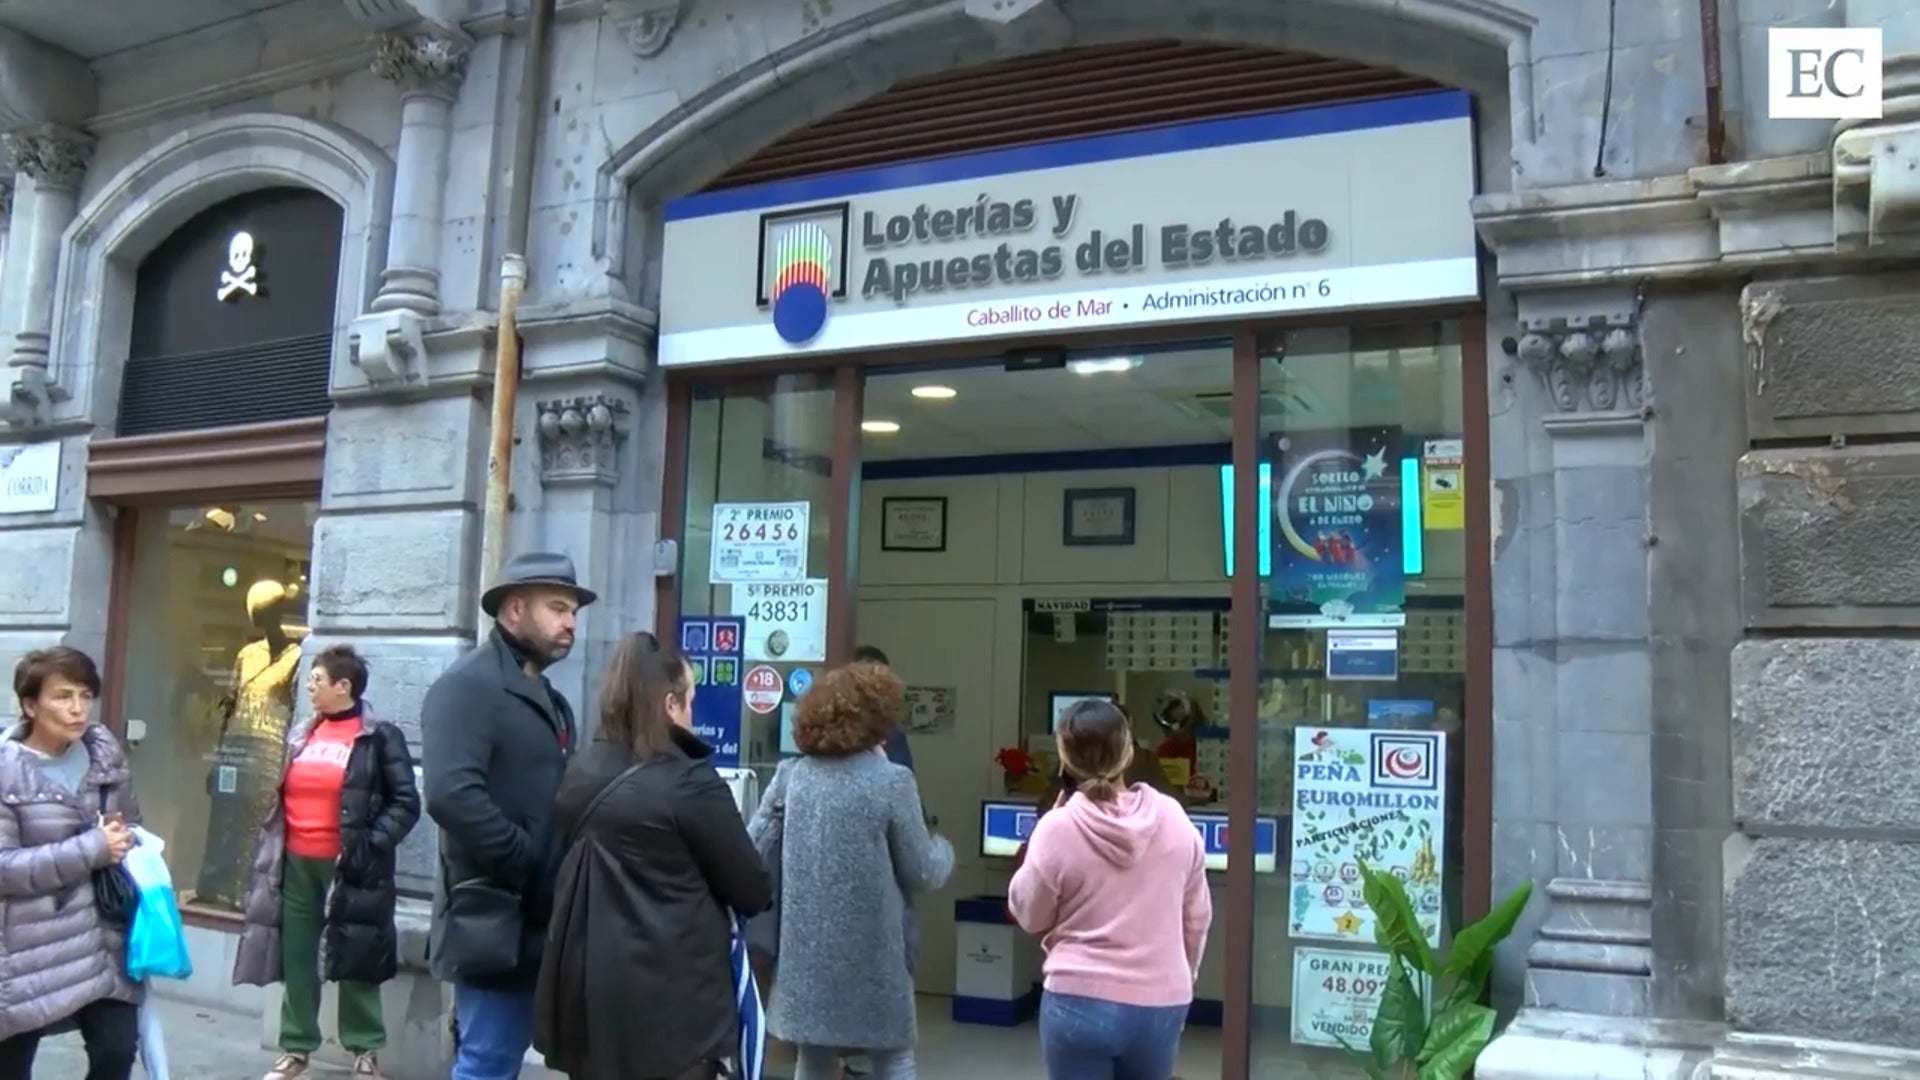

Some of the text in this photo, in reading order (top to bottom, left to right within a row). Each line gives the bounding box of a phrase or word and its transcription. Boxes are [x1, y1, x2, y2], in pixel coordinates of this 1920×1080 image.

[863, 192, 1077, 247] Loterías y
[862, 210, 1329, 303] Apuestas del Estado
[967, 304, 1042, 327] Caballito
[1048, 301, 1071, 320] de
[1078, 299, 1113, 317] Mar
[1142, 282, 1287, 311] Administración
[1318, 279, 1331, 297] 6
[1299, 496, 1319, 513] EL
[747, 508, 794, 521] PREMIO
[724, 523, 798, 541] 26456
[764, 584, 815, 598] PREMIO
[748, 601, 810, 622] 43831
[1037, 601, 1089, 610] NAVIDAD
[1297, 761, 1362, 782] PEÑA
[1297, 790, 1439, 810] EUROMILLON
[1309, 958, 1353, 973] GRAN
[1311, 1020, 1369, 1037] VENDIDO
